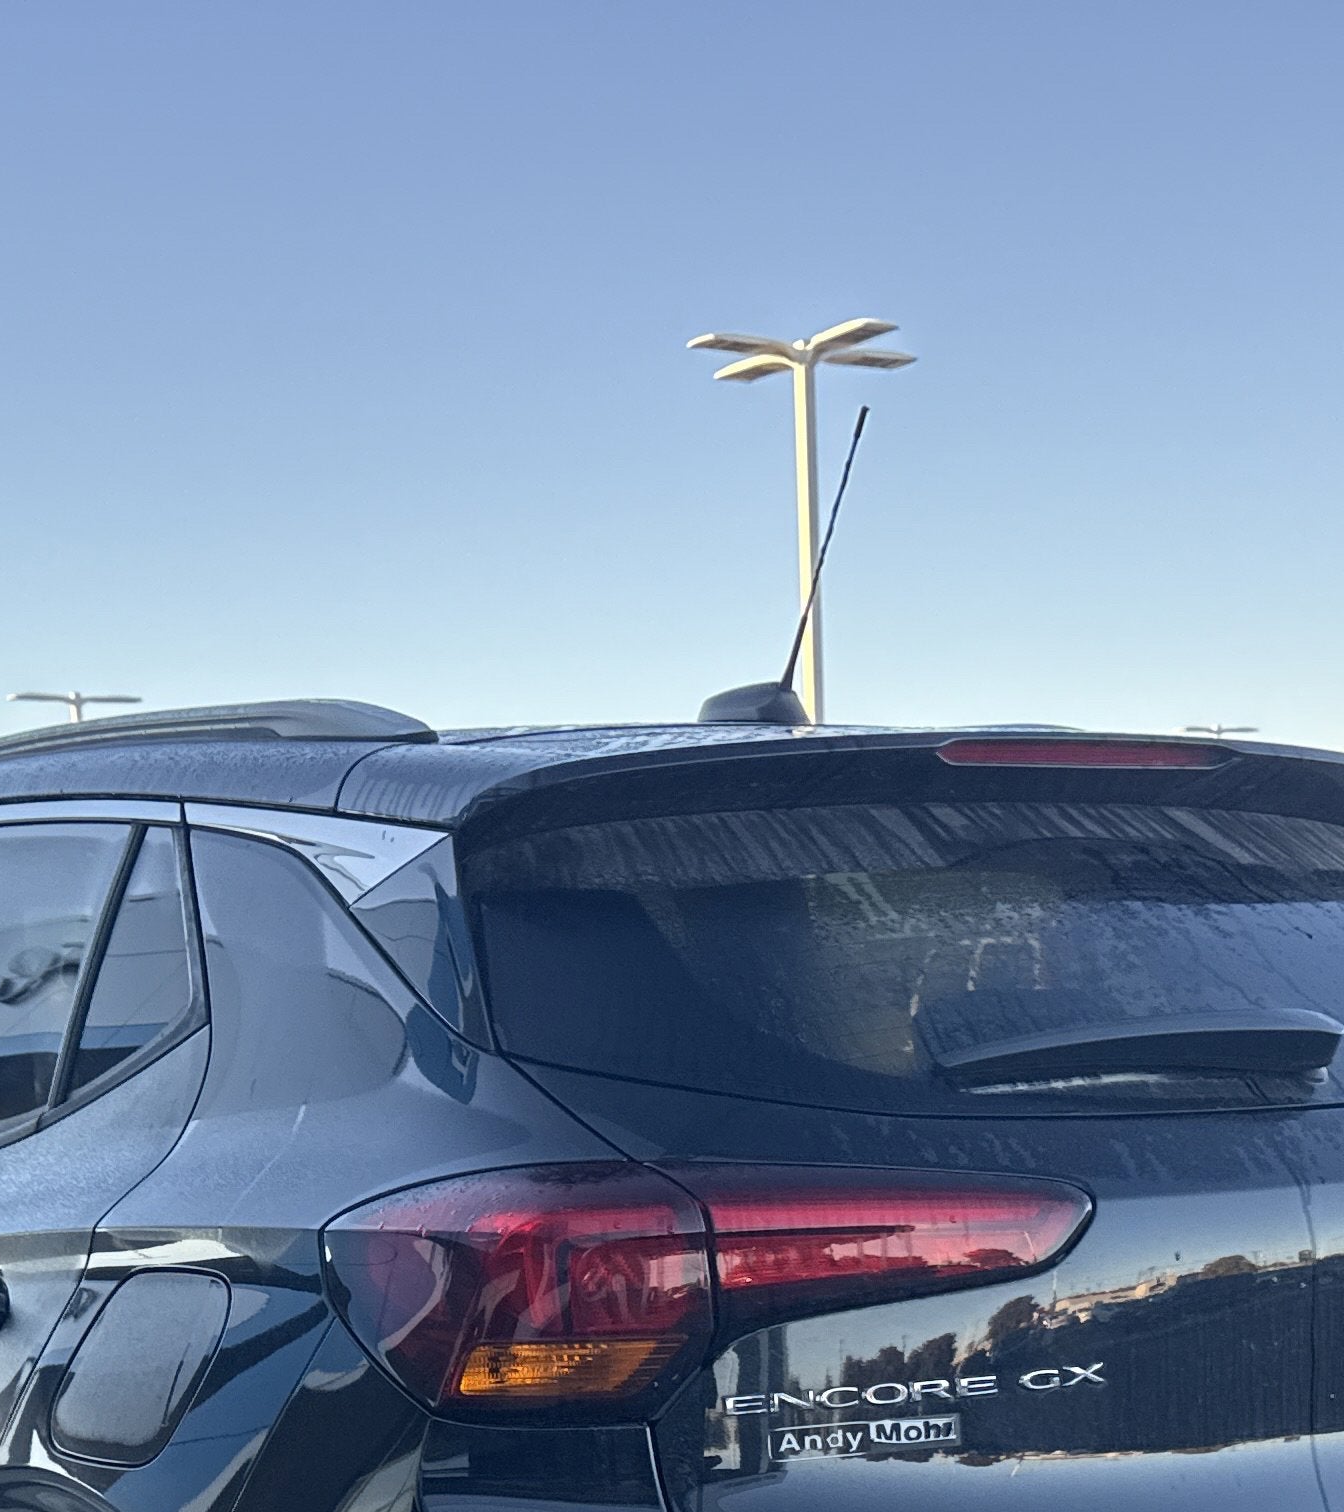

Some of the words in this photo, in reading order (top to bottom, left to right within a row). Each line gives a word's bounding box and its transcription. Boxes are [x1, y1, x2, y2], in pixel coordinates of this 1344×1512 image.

[724, 1374, 997, 1416] ENCORE
[1019, 1361, 1105, 1390] GX
[779, 1429, 864, 1452] Andy
